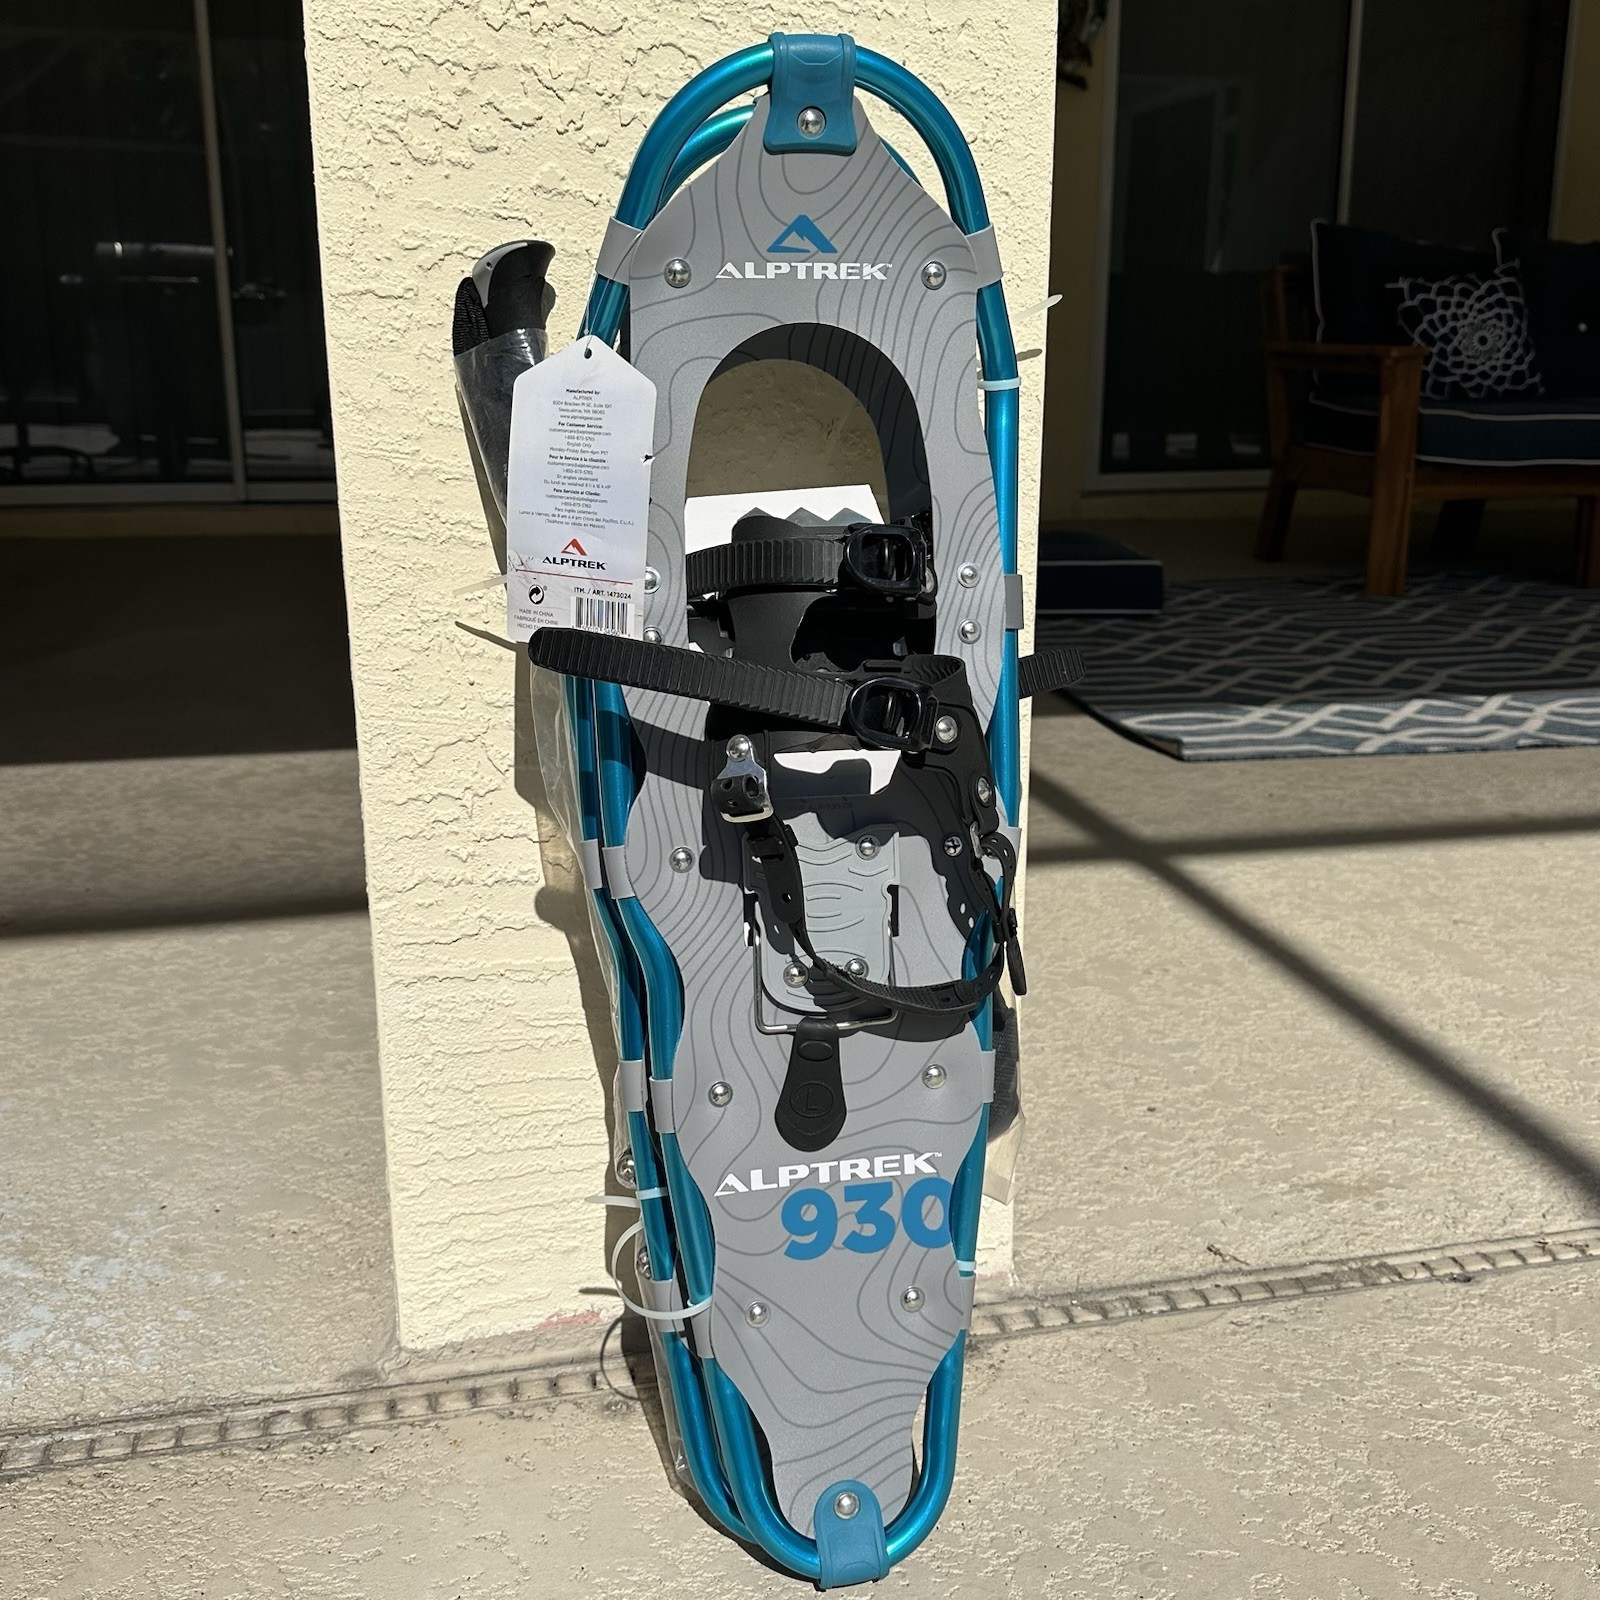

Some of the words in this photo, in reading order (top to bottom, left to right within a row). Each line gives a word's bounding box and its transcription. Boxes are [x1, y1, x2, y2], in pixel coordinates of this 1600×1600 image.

[715, 262, 889, 280] ALPTREK
[542, 556, 606, 570] ALPTREK
[574, 586, 587, 594] ITM.
[592, 589, 605, 597] ART.
[606, 590, 632, 600] 1473024
[805, 1088, 820, 1111] L
[713, 1152, 939, 1197] ALPTREK
[780, 1176, 953, 1261] 930
